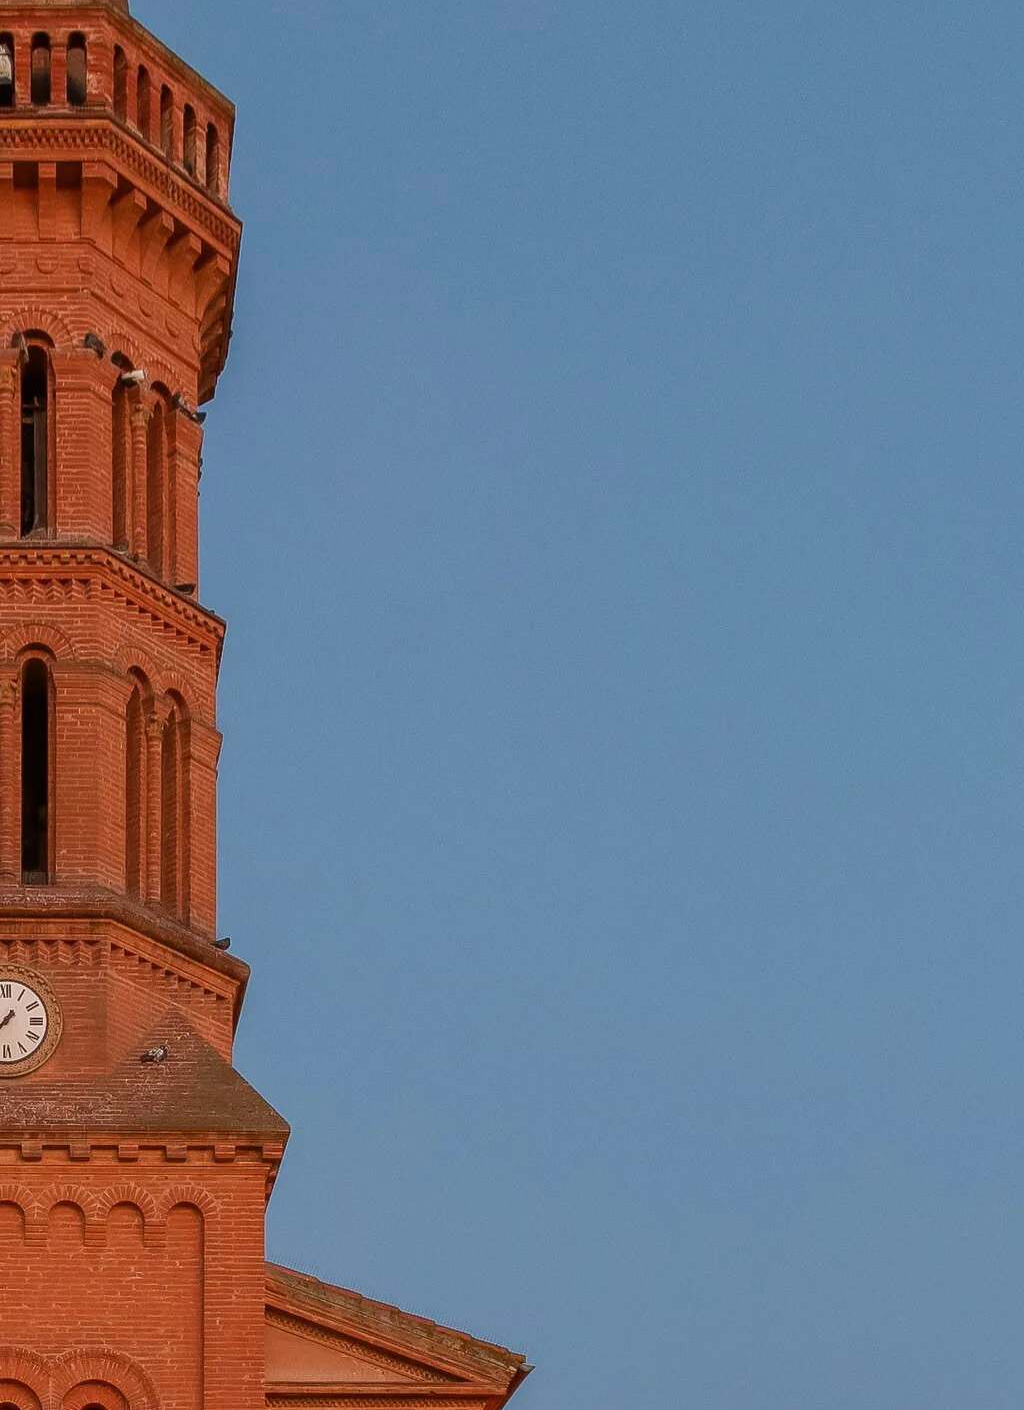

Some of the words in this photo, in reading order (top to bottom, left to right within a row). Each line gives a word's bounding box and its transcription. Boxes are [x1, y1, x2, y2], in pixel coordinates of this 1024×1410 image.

[0, 984, 12, 998] XII
[17, 989, 25, 1001] I
[26, 1001, 39, 1012] II
[29, 1017, 43, 1025] III
[26, 1030, 39, 1043] IV
[3, 1044, 12, 1058] VI
[17, 1041, 28, 1054] V
